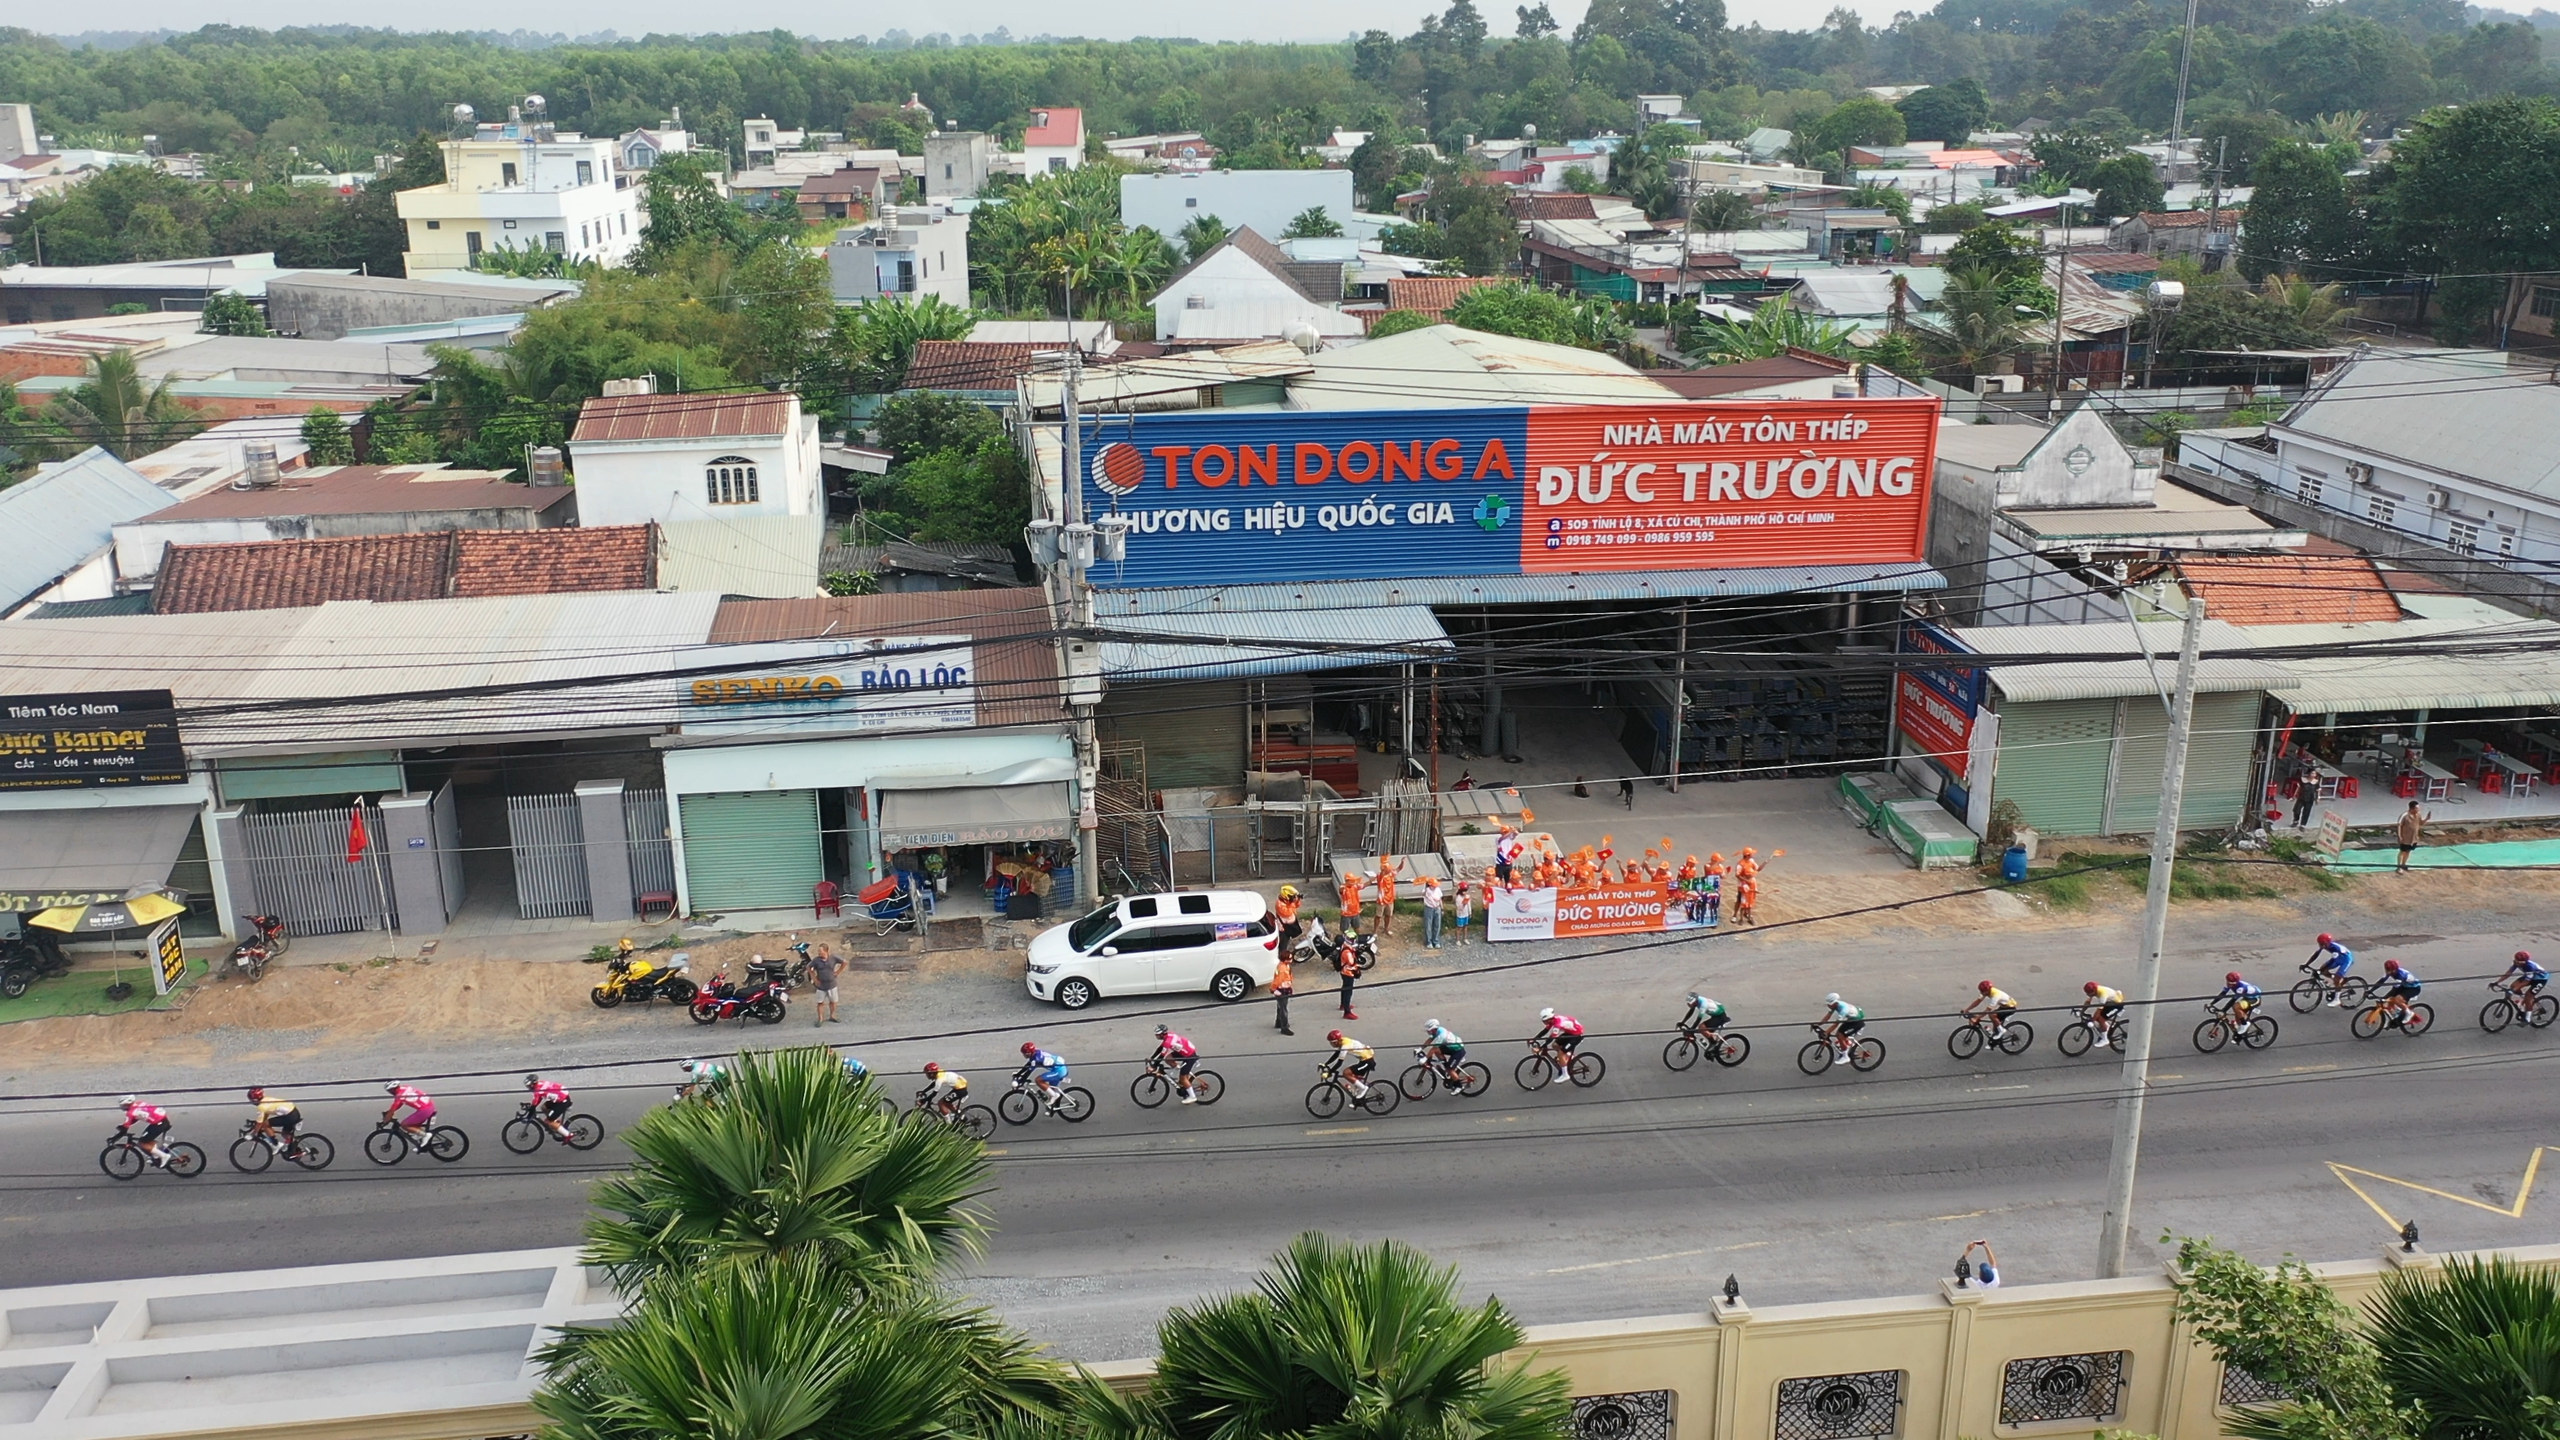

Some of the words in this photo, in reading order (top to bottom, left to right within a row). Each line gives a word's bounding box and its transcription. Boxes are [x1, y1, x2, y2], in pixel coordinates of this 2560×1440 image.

[1603, 417, 1663, 446] NHÀ
[1672, 417, 1733, 444] MÁY
[1740, 415, 1796, 442] TÔN
[1805, 413, 1869, 440] THÉP
[1151, 443, 1278, 489] TON
[1293, 438, 1464, 485] DONG
[1472, 438, 1515, 480] A
[1536, 452, 1657, 506] ĐỨC
[1676, 449, 1915, 502] TRƯỜNG
[1245, 501, 1305, 536] HIỆU
[1318, 494, 1396, 532] QUỐC
[1407, 502, 1455, 525] GIA
[1567, 518, 1588, 530] 509
[1592, 516, 1616, 530] TỈNH
[1620, 516, 1632, 532] LỘ
[1634, 518, 1645, 531] 8,
[1647, 515, 1663, 528] XÃ
[1666, 514, 1681, 528] CỦ
[1705, 513, 1742, 527] THÀNH
[1744, 511, 1766, 525] PHỐ
[1768, 511, 1785, 524] HỒ
[1787, 511, 1806, 524] CHÍ
[1808, 512, 1835, 523] MINH
[1566, 534, 1591, 546] 0918
[1595, 533, 1613, 545] 749
[1617, 533, 1636, 544] 099
[1645, 532, 1670, 544] 0986
[1672, 531, 1692, 543] 959
[1695, 531, 1715, 542] 595
[861, 663, 911, 689] BẢO
[920, 661, 967, 695] LỘC
[691, 675, 843, 705] SENKO
[49, 703, 78, 716] Tóc
[82, 703, 119, 715] Nam
[1903, 682, 1923, 707] ĐỨC
[1925, 695, 1964, 737] TRƯỜNG
[14, 757, 35, 769] CẮT
[53, 755, 78, 768] UỐN
[93, 755, 135, 767] NHUỘM
[959, 826, 1009, 843] BẢO
[1015, 825, 1065, 840] LỘC
[37, 890, 91, 909] TÓC
[1588, 890, 1610, 901] MÁY
[1612, 890, 1632, 900] TÔN
[1634, 890, 1657, 899] THÉP
[1496, 917, 1515, 925] TON
[1557, 904, 1593, 922] ĐỨC
[1597, 901, 1662, 920] TRƯỜNG
